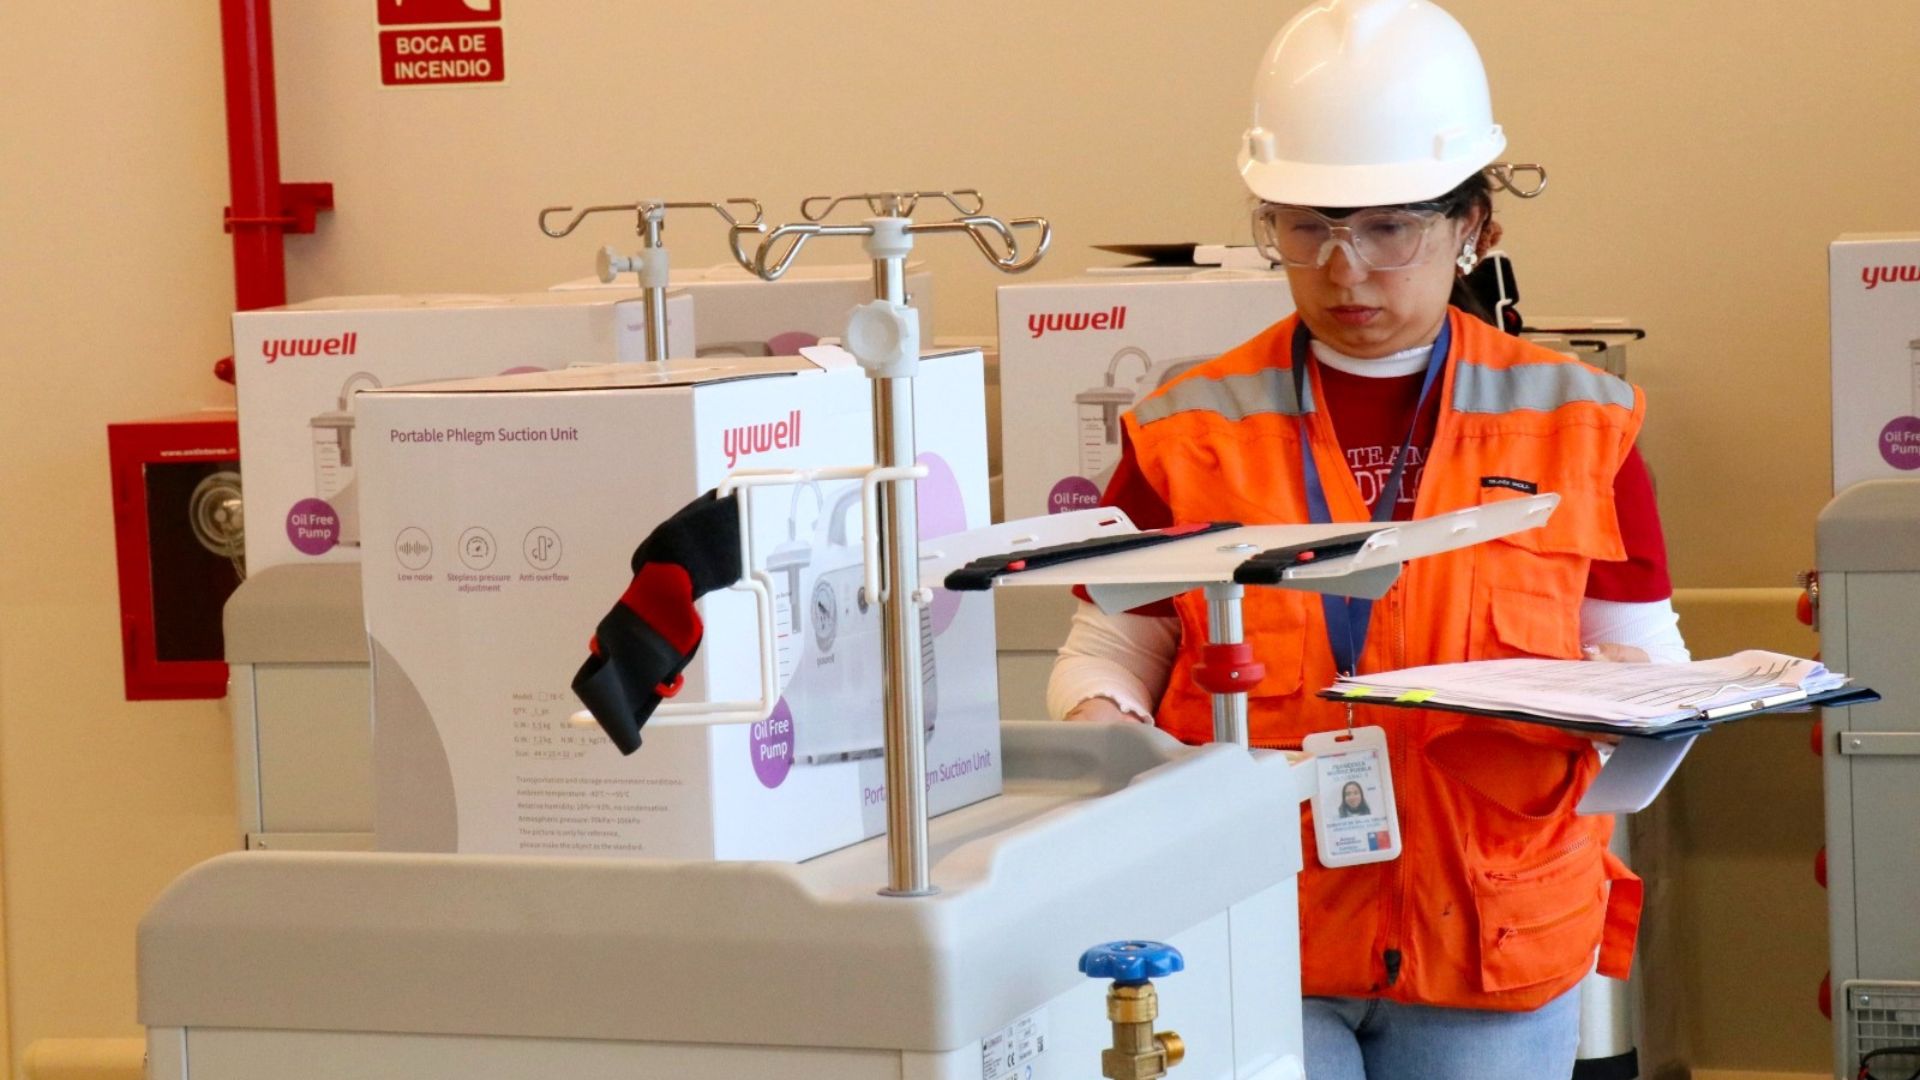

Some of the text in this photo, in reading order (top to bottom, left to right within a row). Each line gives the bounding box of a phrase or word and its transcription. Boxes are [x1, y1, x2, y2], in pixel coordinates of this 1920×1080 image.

[396, 34, 486, 55] BOCA DE
[395, 59, 491, 79] INCENDIO
[1862, 265, 1920, 289] yuw
[1028, 306, 1126, 338] yuwell
[262, 332, 357, 364] yuwell
[390, 427, 578, 445] Portable Phlegm Suction Unit
[723, 410, 801, 468] yuwell
[1885, 431, 1920, 443] Oil Fre
[1347, 446, 1428, 468] TEAM
[1891, 444, 1920, 456] Pum
[1054, 492, 1098, 504] Oil Free
[291, 513, 334, 526] Oil Free
[298, 527, 331, 540] Pump
[447, 573, 511, 583] Stepless pressure
[519, 573, 569, 581] Anti overflow
[458, 584, 501, 593] adjustment
[754, 719, 789, 741] Oil Free
[760, 742, 787, 762] Pump
[864, 786, 885, 806] Port
[940, 758, 972, 782] Suction
[973, 749, 992, 771] Unit
